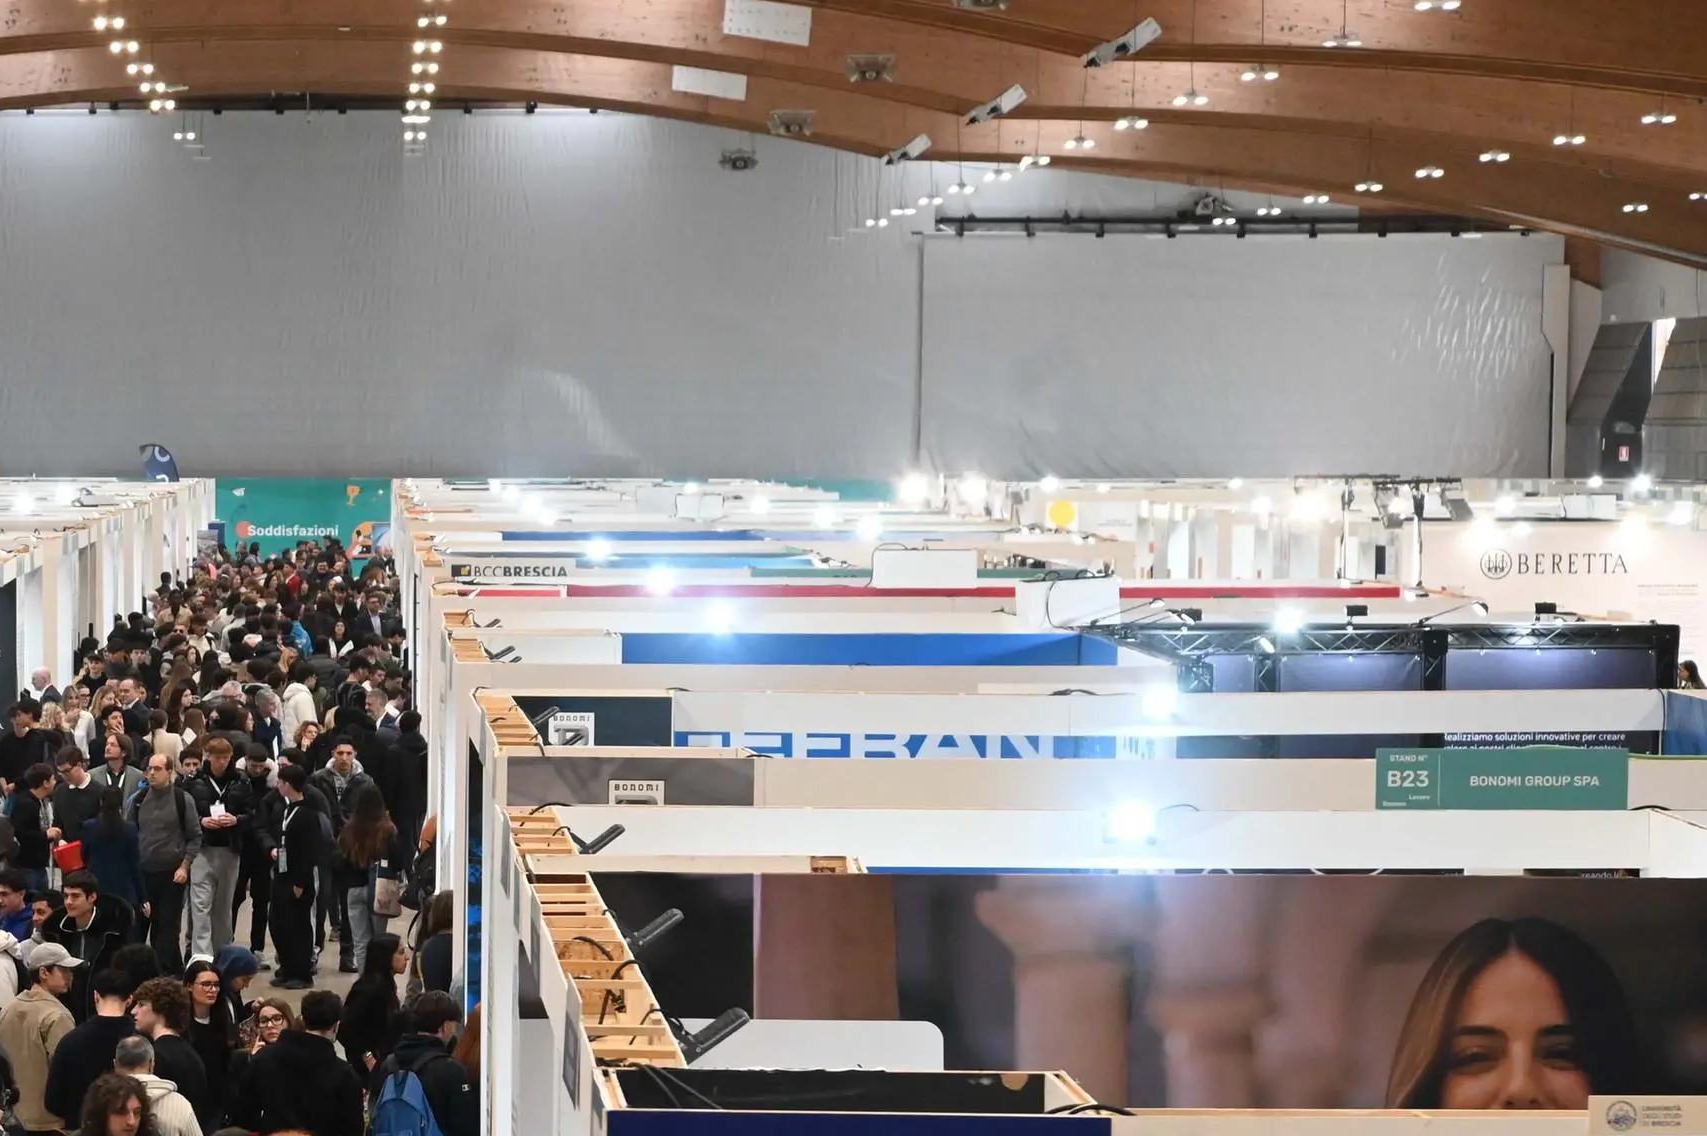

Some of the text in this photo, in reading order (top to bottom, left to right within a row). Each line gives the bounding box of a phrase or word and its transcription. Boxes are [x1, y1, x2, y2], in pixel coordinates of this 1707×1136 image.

[247, 524, 339, 537] Soddisfazioni
[1517, 553, 1628, 574] BERETTA
[1494, 732, 1534, 742] soluzioni
[1535, 732, 1580, 742] innovative
[1582, 734, 1596, 744] per
[1389, 754, 1417, 762] STAND
[1387, 770, 1429, 788] B23
[1469, 775, 1600, 787] BONOMI GROUP SPA
